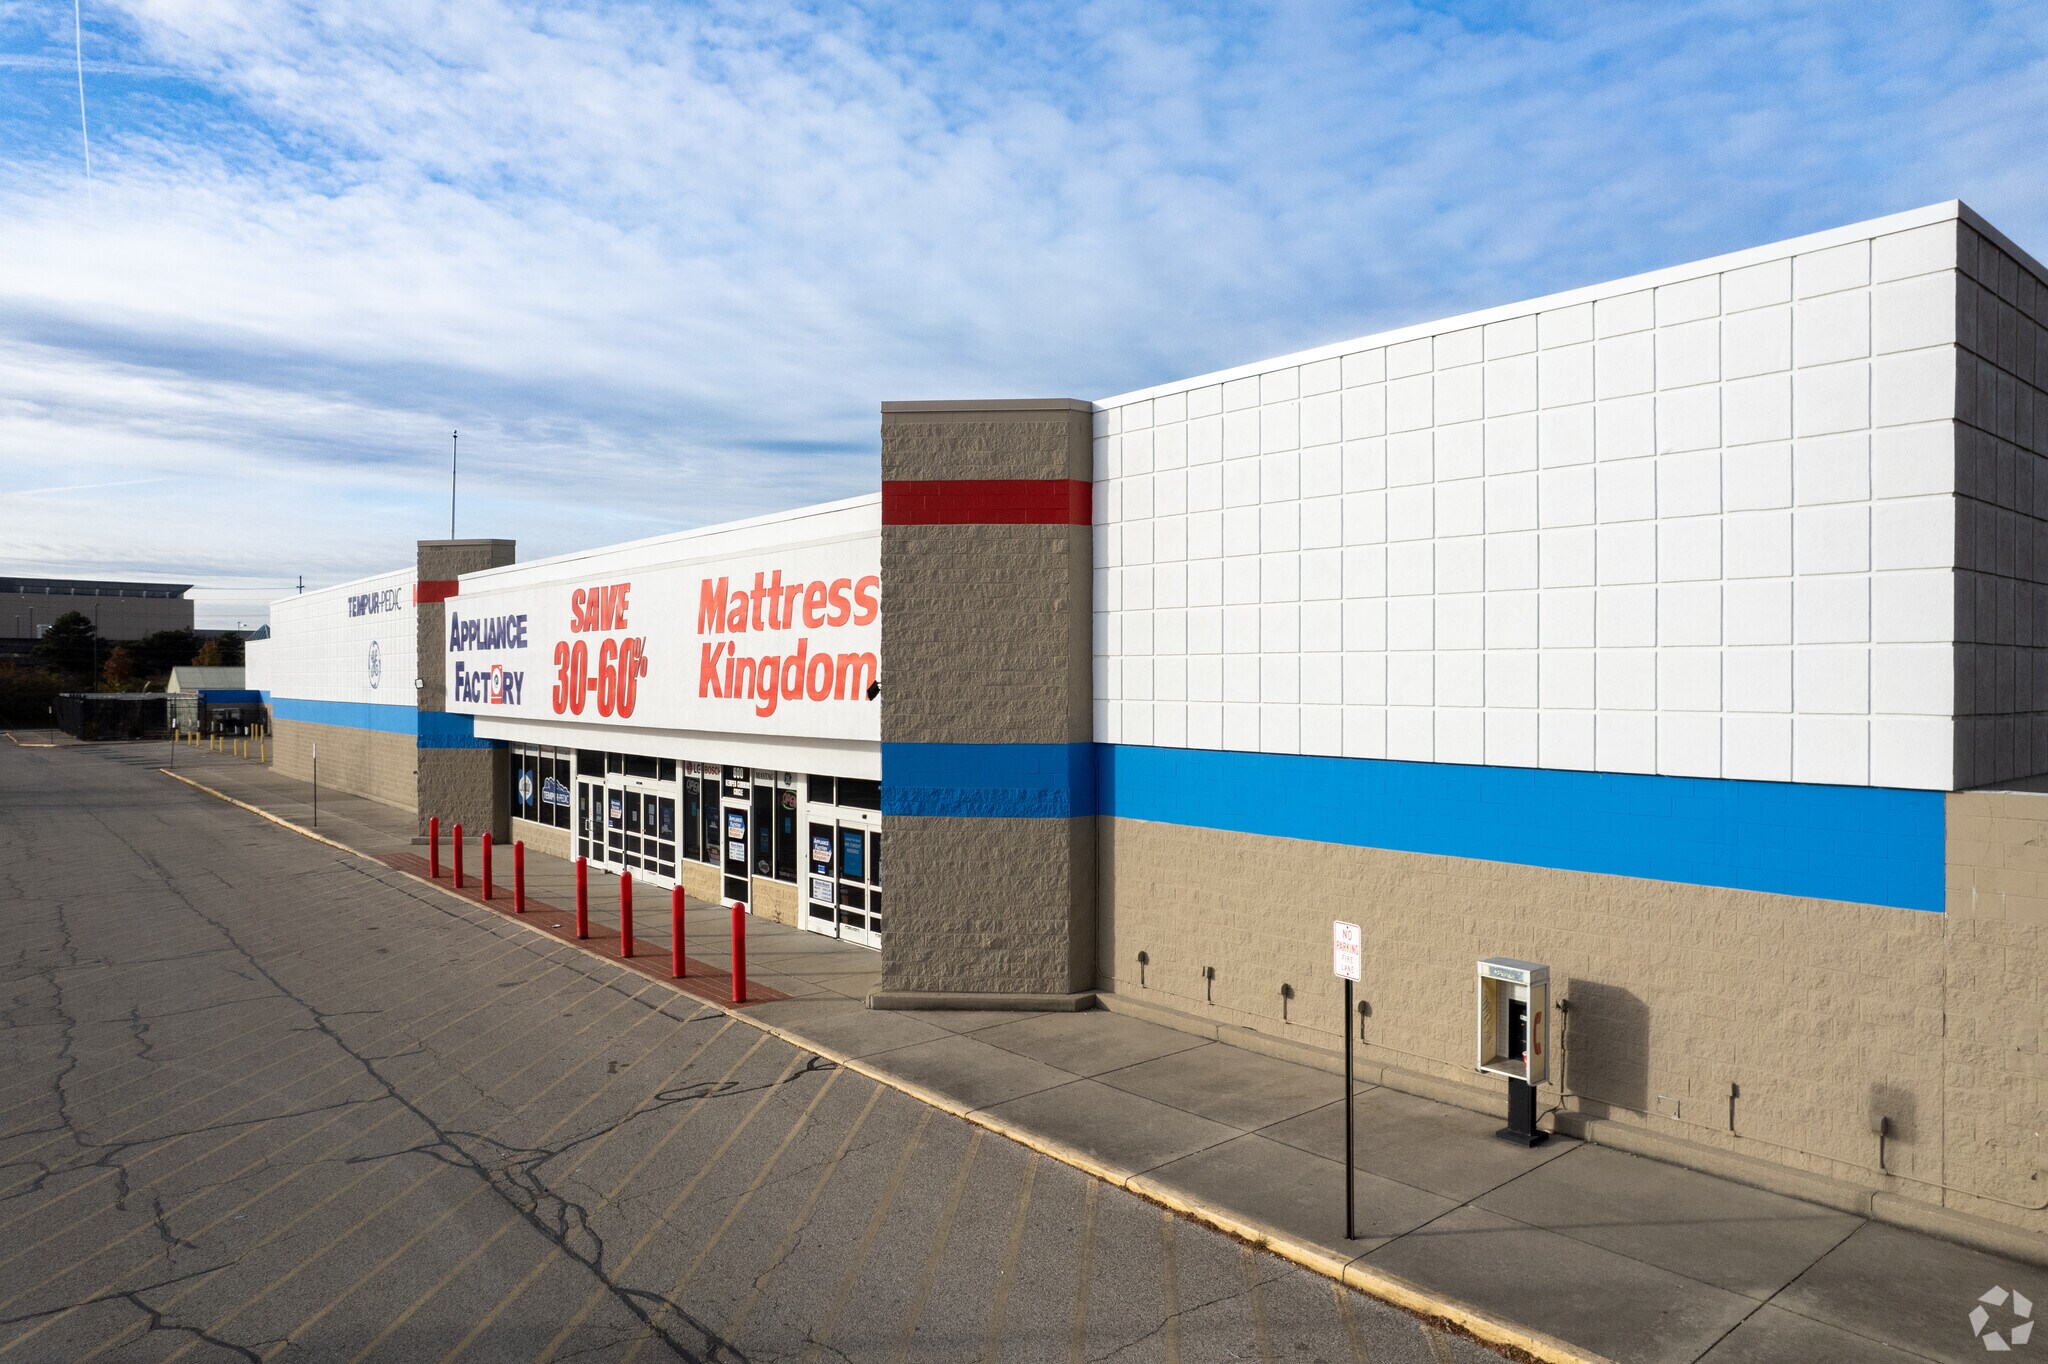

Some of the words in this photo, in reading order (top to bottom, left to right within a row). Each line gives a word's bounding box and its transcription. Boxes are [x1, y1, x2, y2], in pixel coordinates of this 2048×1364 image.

[348, 587, 402, 618] TEMPUR-PEDIC
[570, 583, 631, 633] SAVE
[697, 569, 880, 636] Mattress
[449, 611, 528, 652] APPLIANCE
[552, 636, 648, 718] 30-60%
[698, 637, 878, 717] Kingdom
[1336, 940, 1359, 955] PARKING
[1342, 929, 1353, 941] NO
